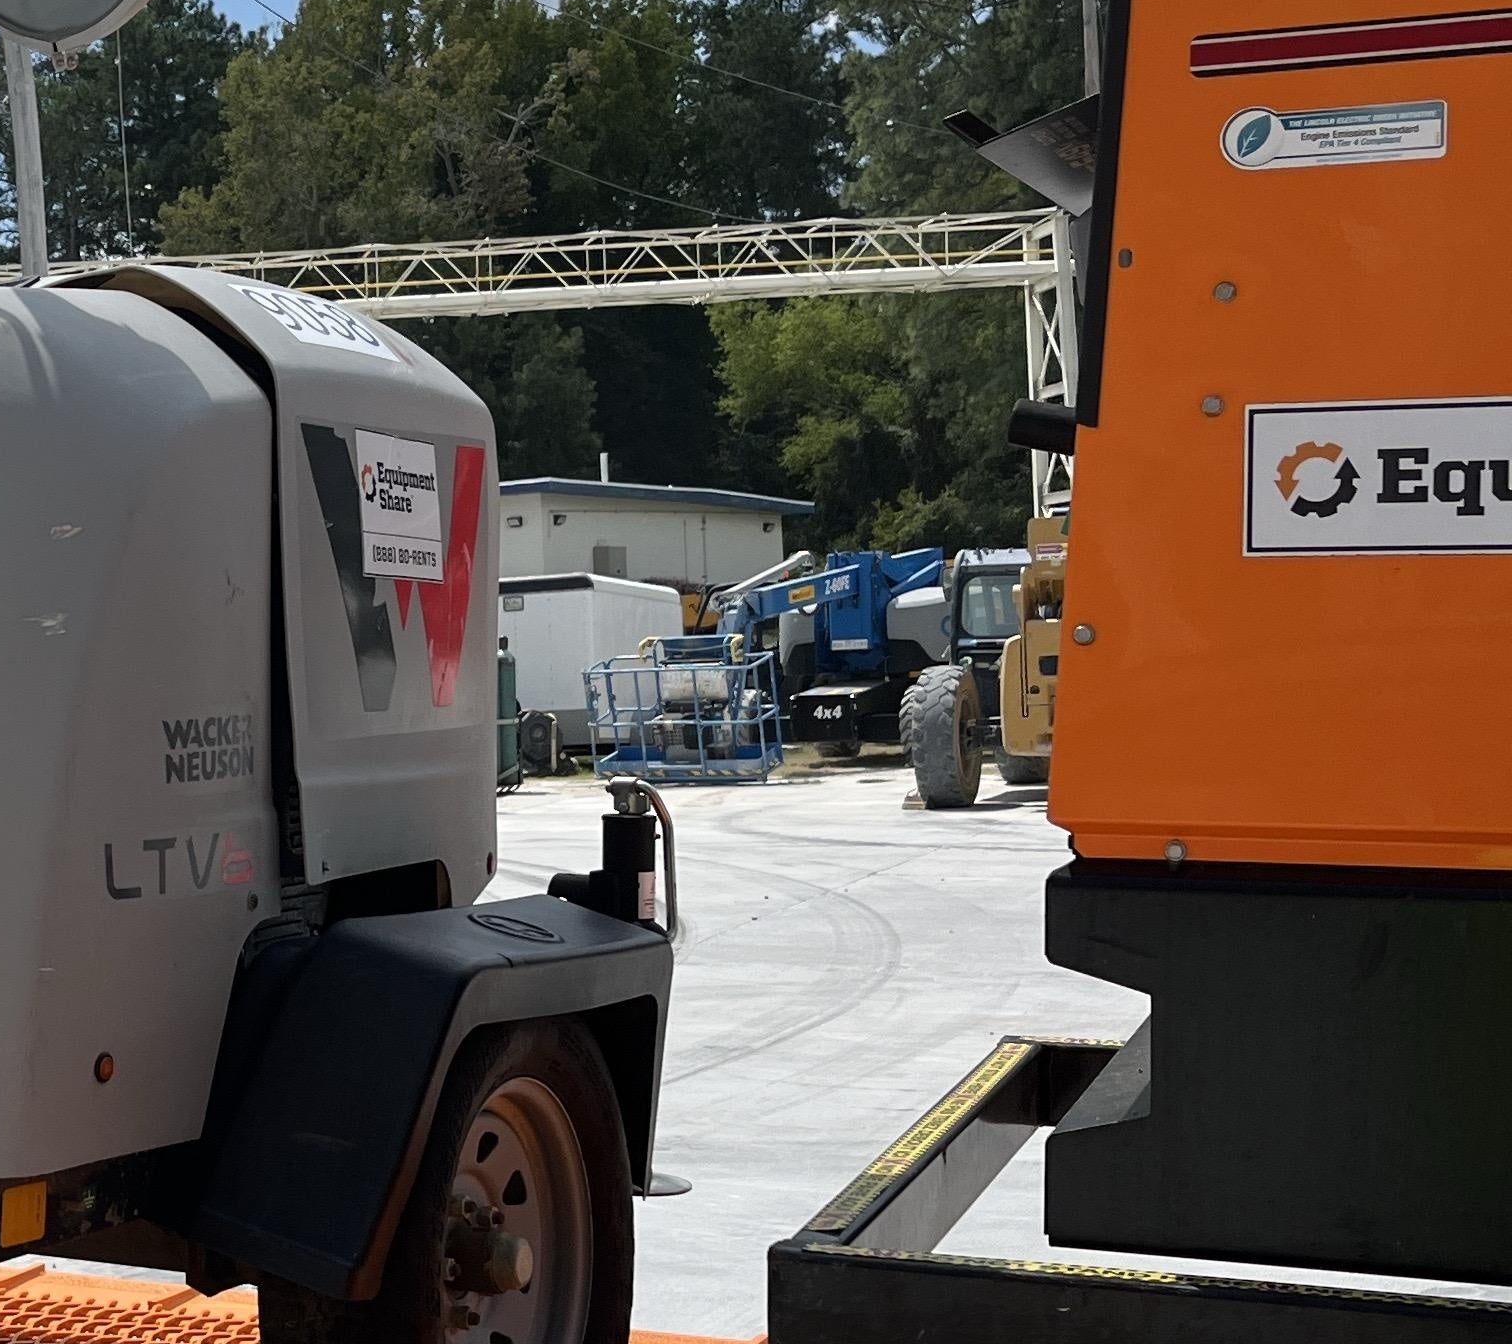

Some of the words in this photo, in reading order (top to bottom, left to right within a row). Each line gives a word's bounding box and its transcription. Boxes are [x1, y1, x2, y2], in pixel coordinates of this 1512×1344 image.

[1300, 131, 1330, 142] Engine
[1332, 128, 1376, 138] Emissions
[377, 462, 435, 492] Equipment
[380, 488, 413, 513] Share
[812, 705, 843, 720] 4x4
[161, 715, 252, 750] WACKER
[165, 746, 255, 784] NEUSON
